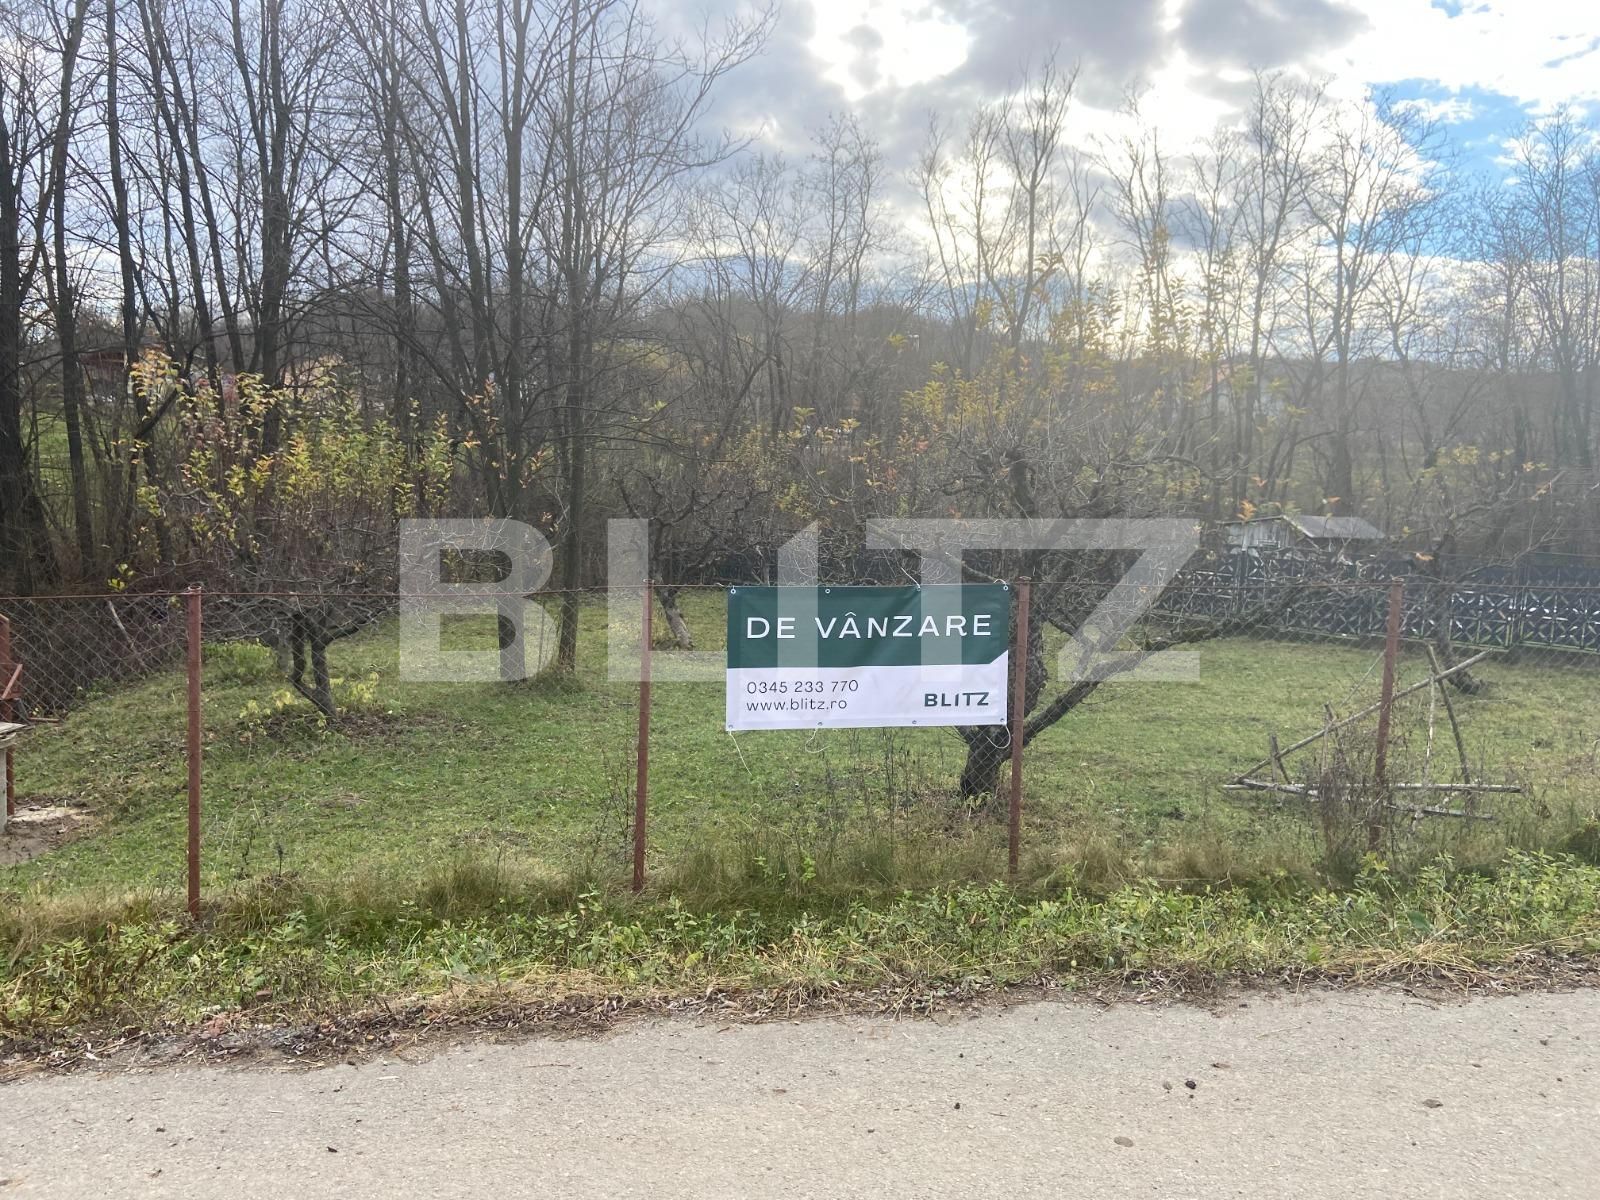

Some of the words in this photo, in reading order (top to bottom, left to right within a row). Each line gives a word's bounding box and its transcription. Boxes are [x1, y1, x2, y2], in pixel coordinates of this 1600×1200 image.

[746, 617, 796, 639] DE
[815, 611, 992, 639] VÂNZARE
[746, 681, 788, 694] 0345
[794, 680, 824, 693] 233
[831, 679, 859, 692] 770
[746, 698, 848, 712] www.blitz.ro
[924, 692, 989, 707] BLITZ
